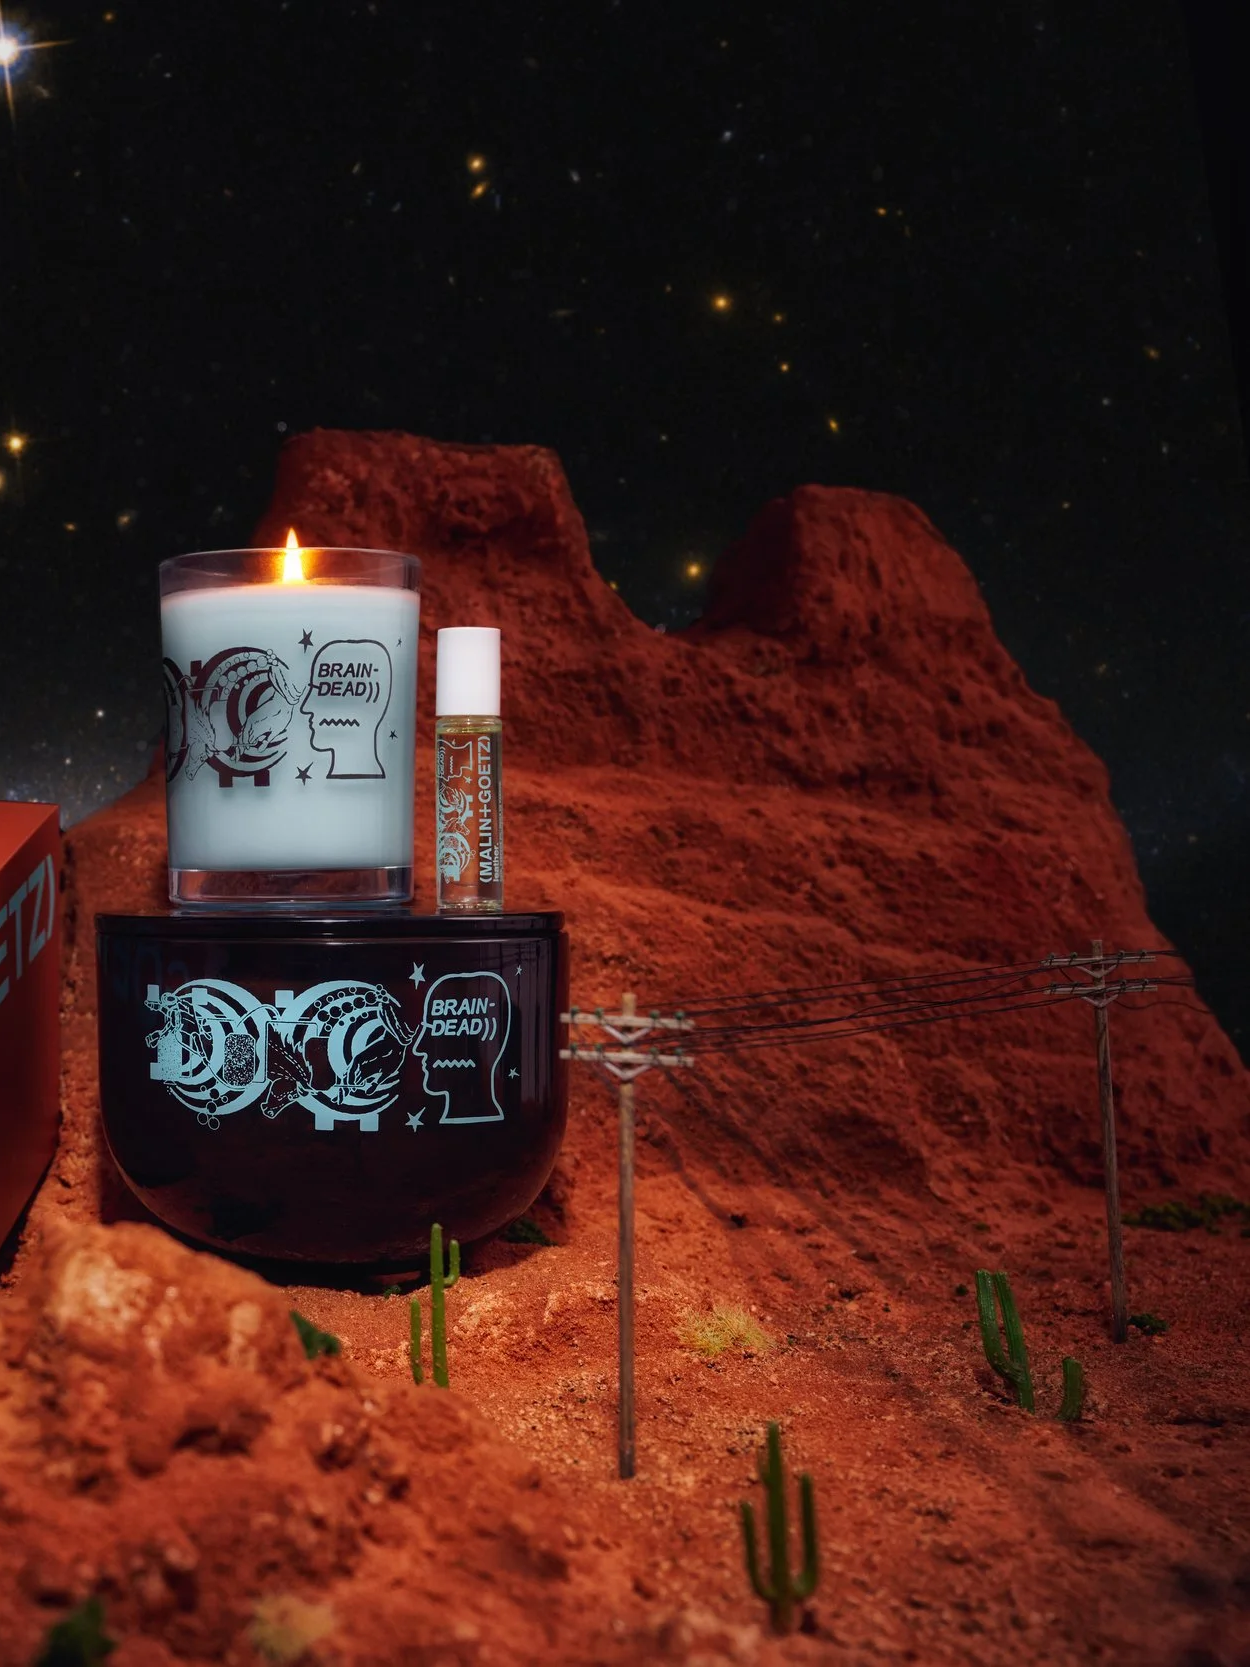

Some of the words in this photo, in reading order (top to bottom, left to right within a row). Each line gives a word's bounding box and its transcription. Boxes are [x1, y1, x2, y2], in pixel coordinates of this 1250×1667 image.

[318, 662, 379, 678] BRAIN-
[477, 735, 493, 883] (MALIN+GOETZ)
[431, 997, 496, 1016] BRAIN-
